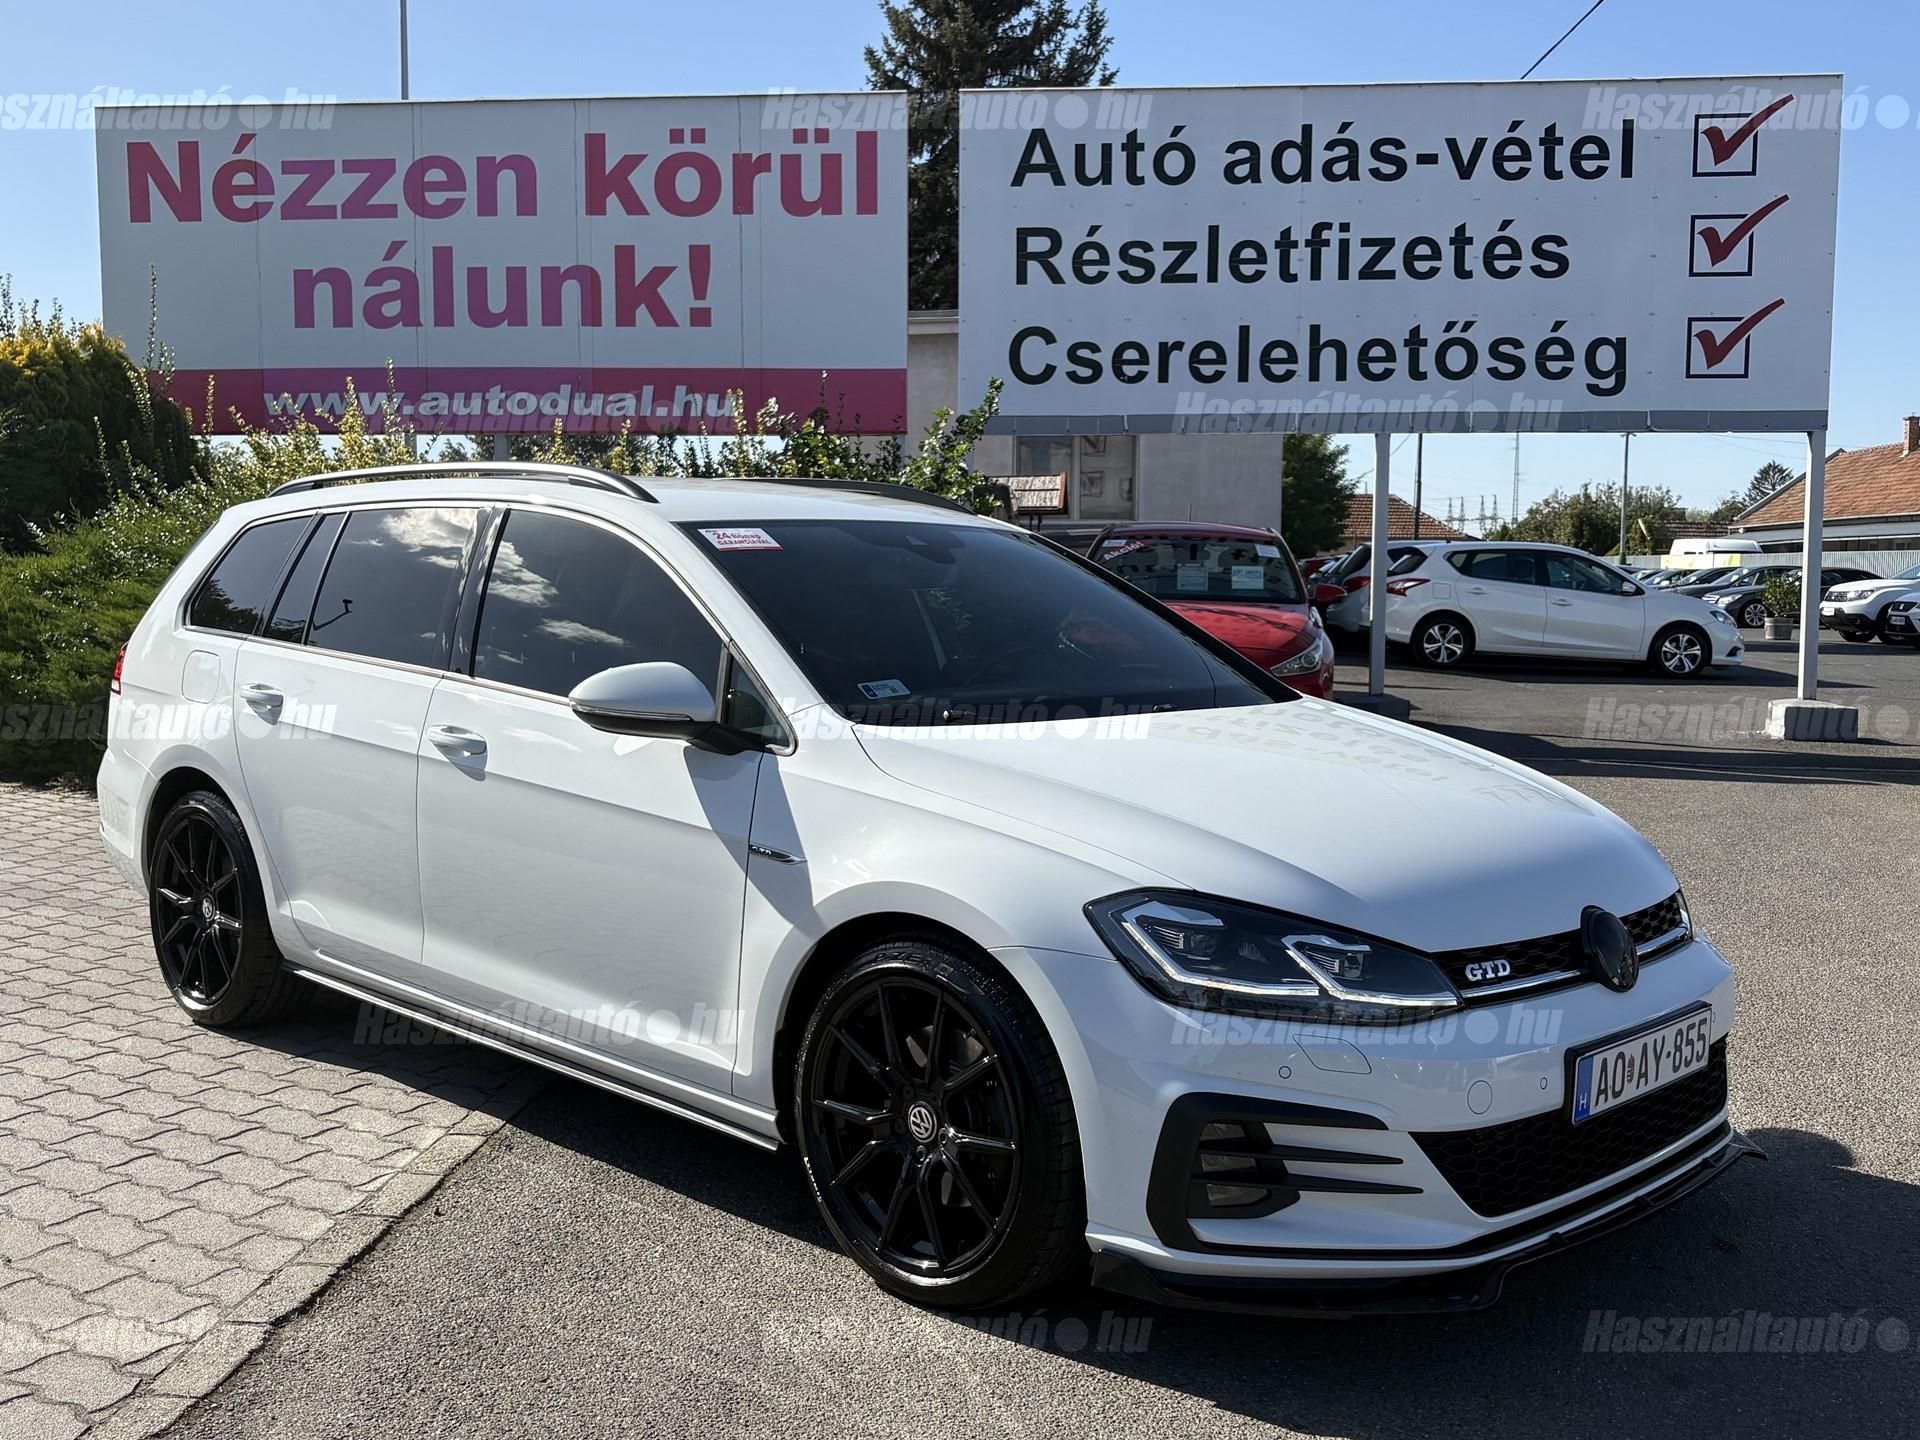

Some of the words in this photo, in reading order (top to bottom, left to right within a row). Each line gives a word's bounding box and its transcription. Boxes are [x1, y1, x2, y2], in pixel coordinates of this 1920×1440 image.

[126, 132, 538, 223] Nézzen
[584, 127, 879, 217] körül
[1010, 124, 1197, 187] Autó
[1222, 119, 1635, 184] adás-vétel
[293, 240, 712, 329] nálunk!
[1015, 218, 1570, 286] Részletfizetés
[1008, 319, 1628, 398] Cserelehetőség
[263, 384, 736, 417] www.autodual.hu
[1465, 958, 1511, 982] GTD
